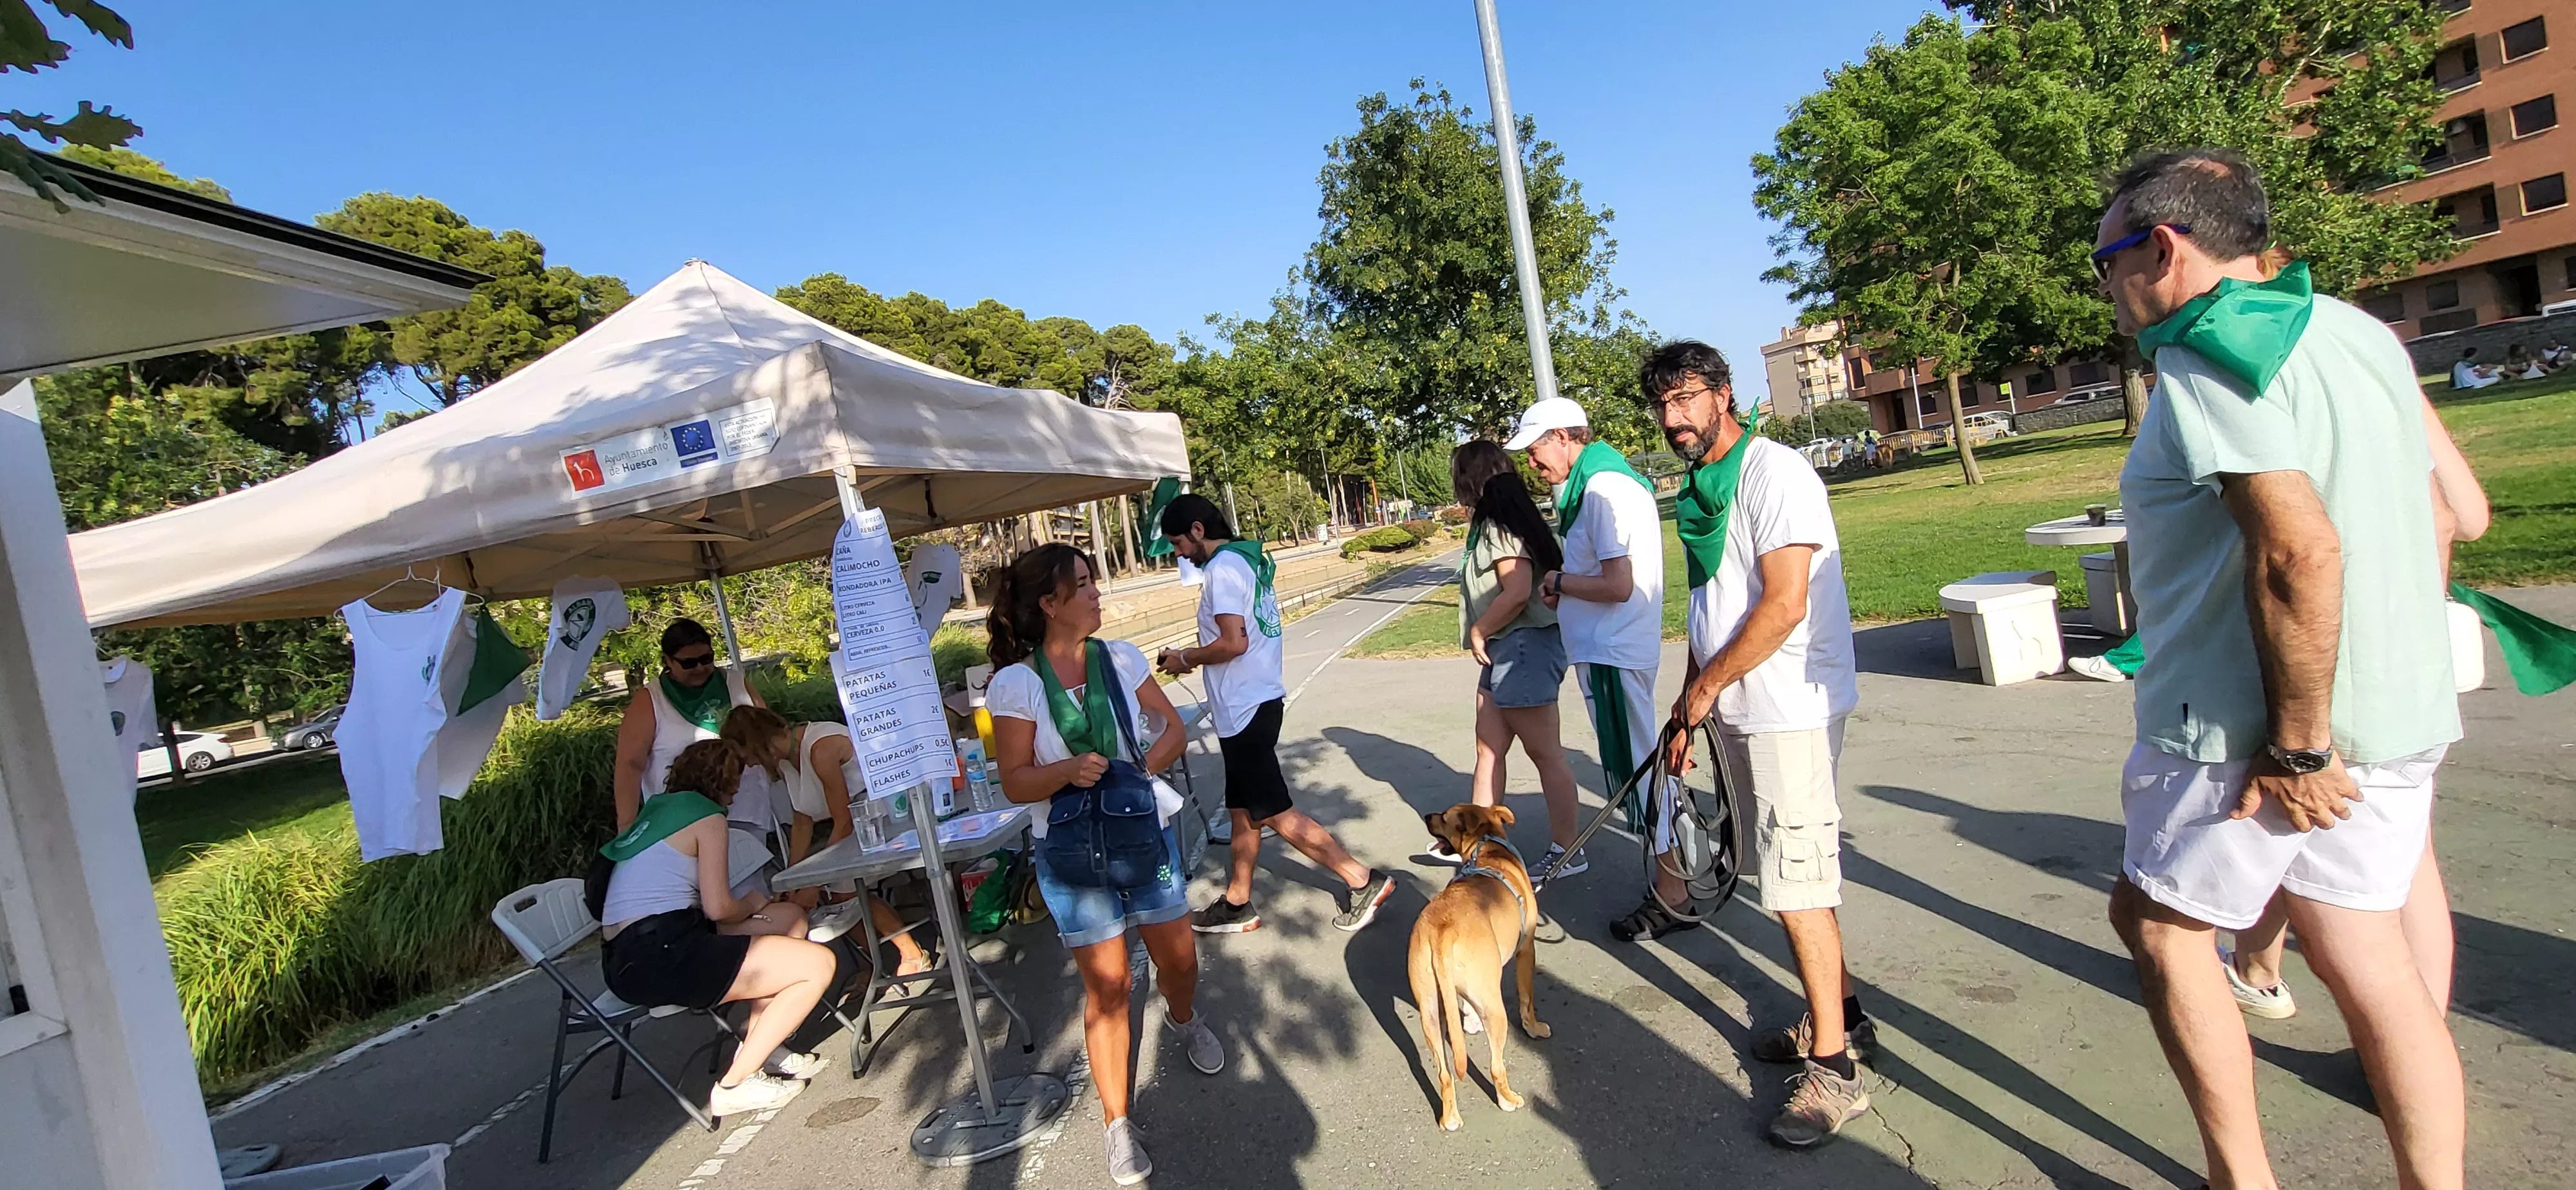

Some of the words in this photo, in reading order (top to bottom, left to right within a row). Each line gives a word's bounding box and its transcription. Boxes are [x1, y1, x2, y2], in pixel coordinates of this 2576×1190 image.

[605, 442, 668, 466] Ayuntamiento
[609, 468, 620, 476] de
[622, 458, 658, 473] Huesca
[837, 545, 851, 555] CAÑA
[837, 560, 880, 572] CALIMOCHO
[846, 629, 874, 639] CERVEZA
[846, 671, 886, 688] PATATAS
[923, 668, 931, 677] 1€
[849, 681, 897, 700] PEQUEÑAS
[856, 707, 896, 725] PATATAS
[931, 705, 939, 714] 2€
[860, 718, 902, 737] GRANDES
[869, 743, 924, 768] CHUPACHUPS
[935, 739, 949, 748] 0,5€
[873, 770, 911, 788] FLASHES
[945, 758, 953, 766] 1€
